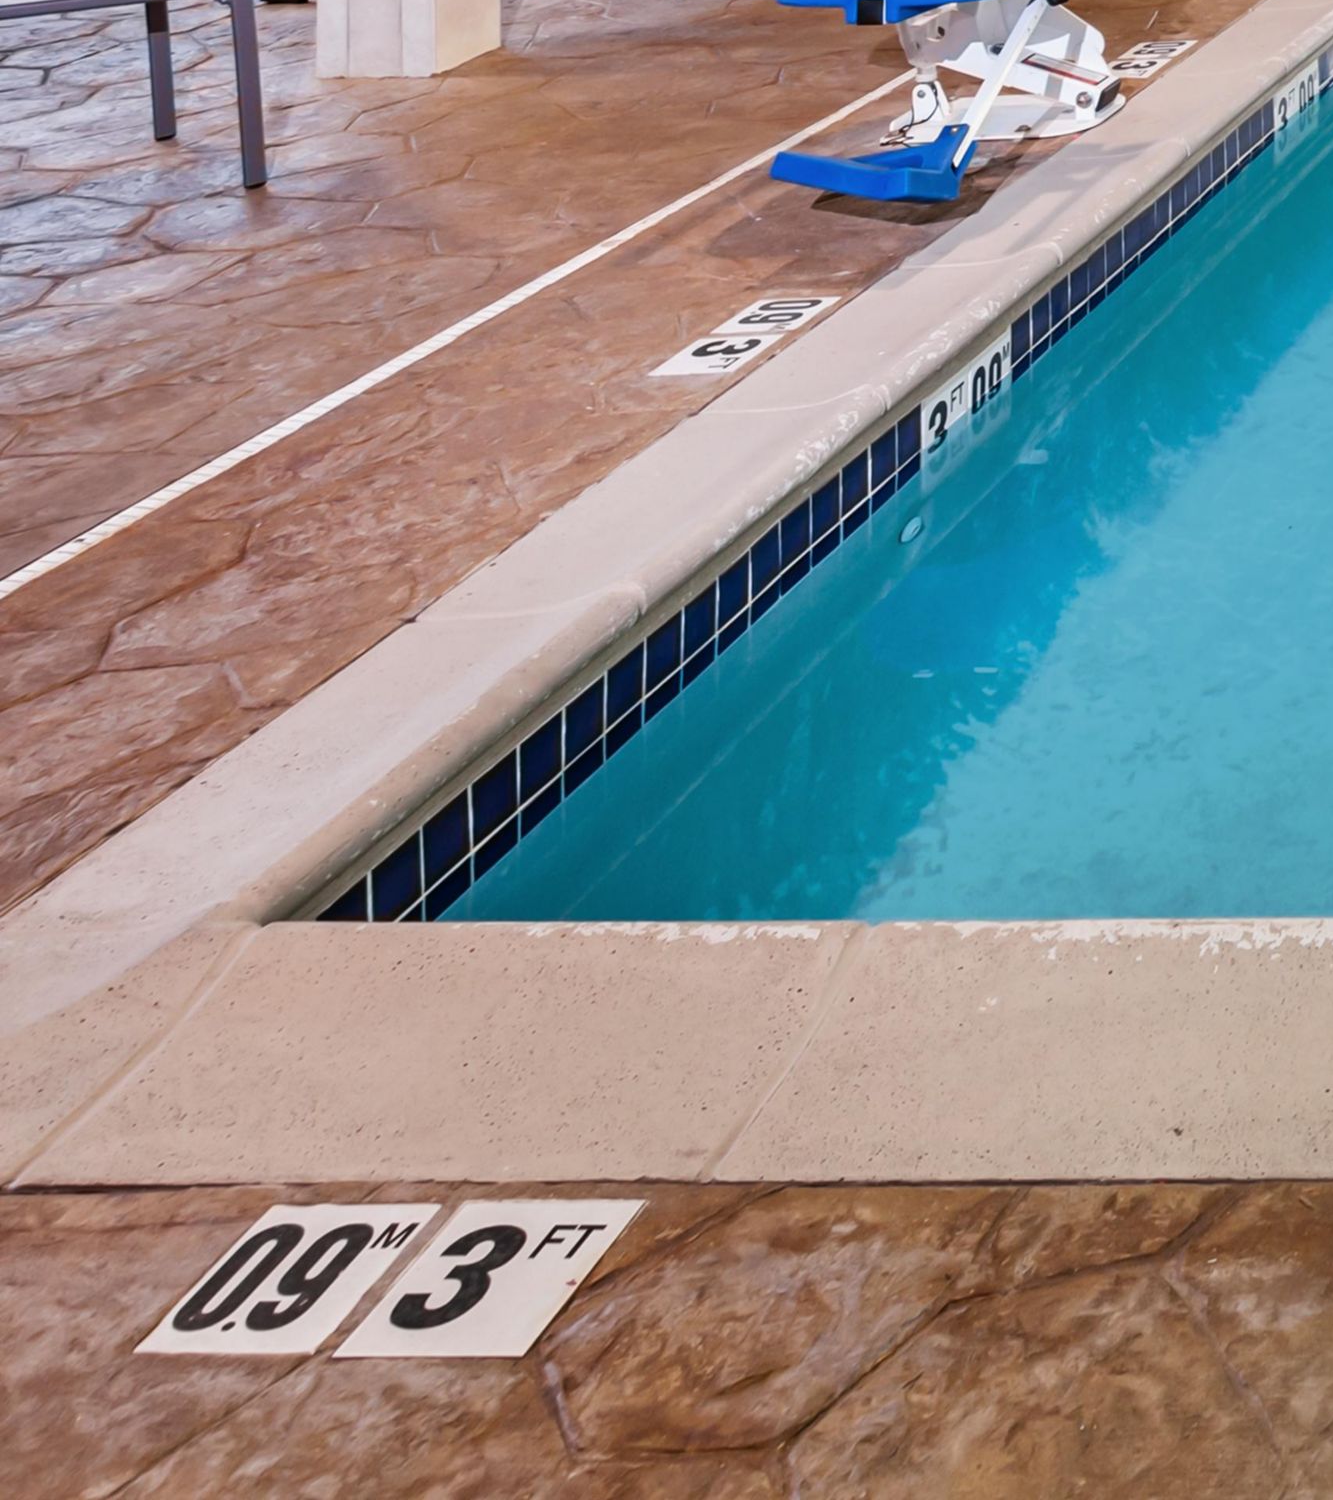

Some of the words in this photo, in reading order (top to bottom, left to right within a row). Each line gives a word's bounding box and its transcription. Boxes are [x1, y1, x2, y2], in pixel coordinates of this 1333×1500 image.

[691, 338, 762, 358] 3
[928, 400, 948, 455] 3
[950, 381, 965, 413] FT
[369, 1222, 420, 1250] M
[527, 1224, 607, 1261] FT
[172, 1223, 374, 1332] 0.9
[389, 1224, 527, 1331] 3
